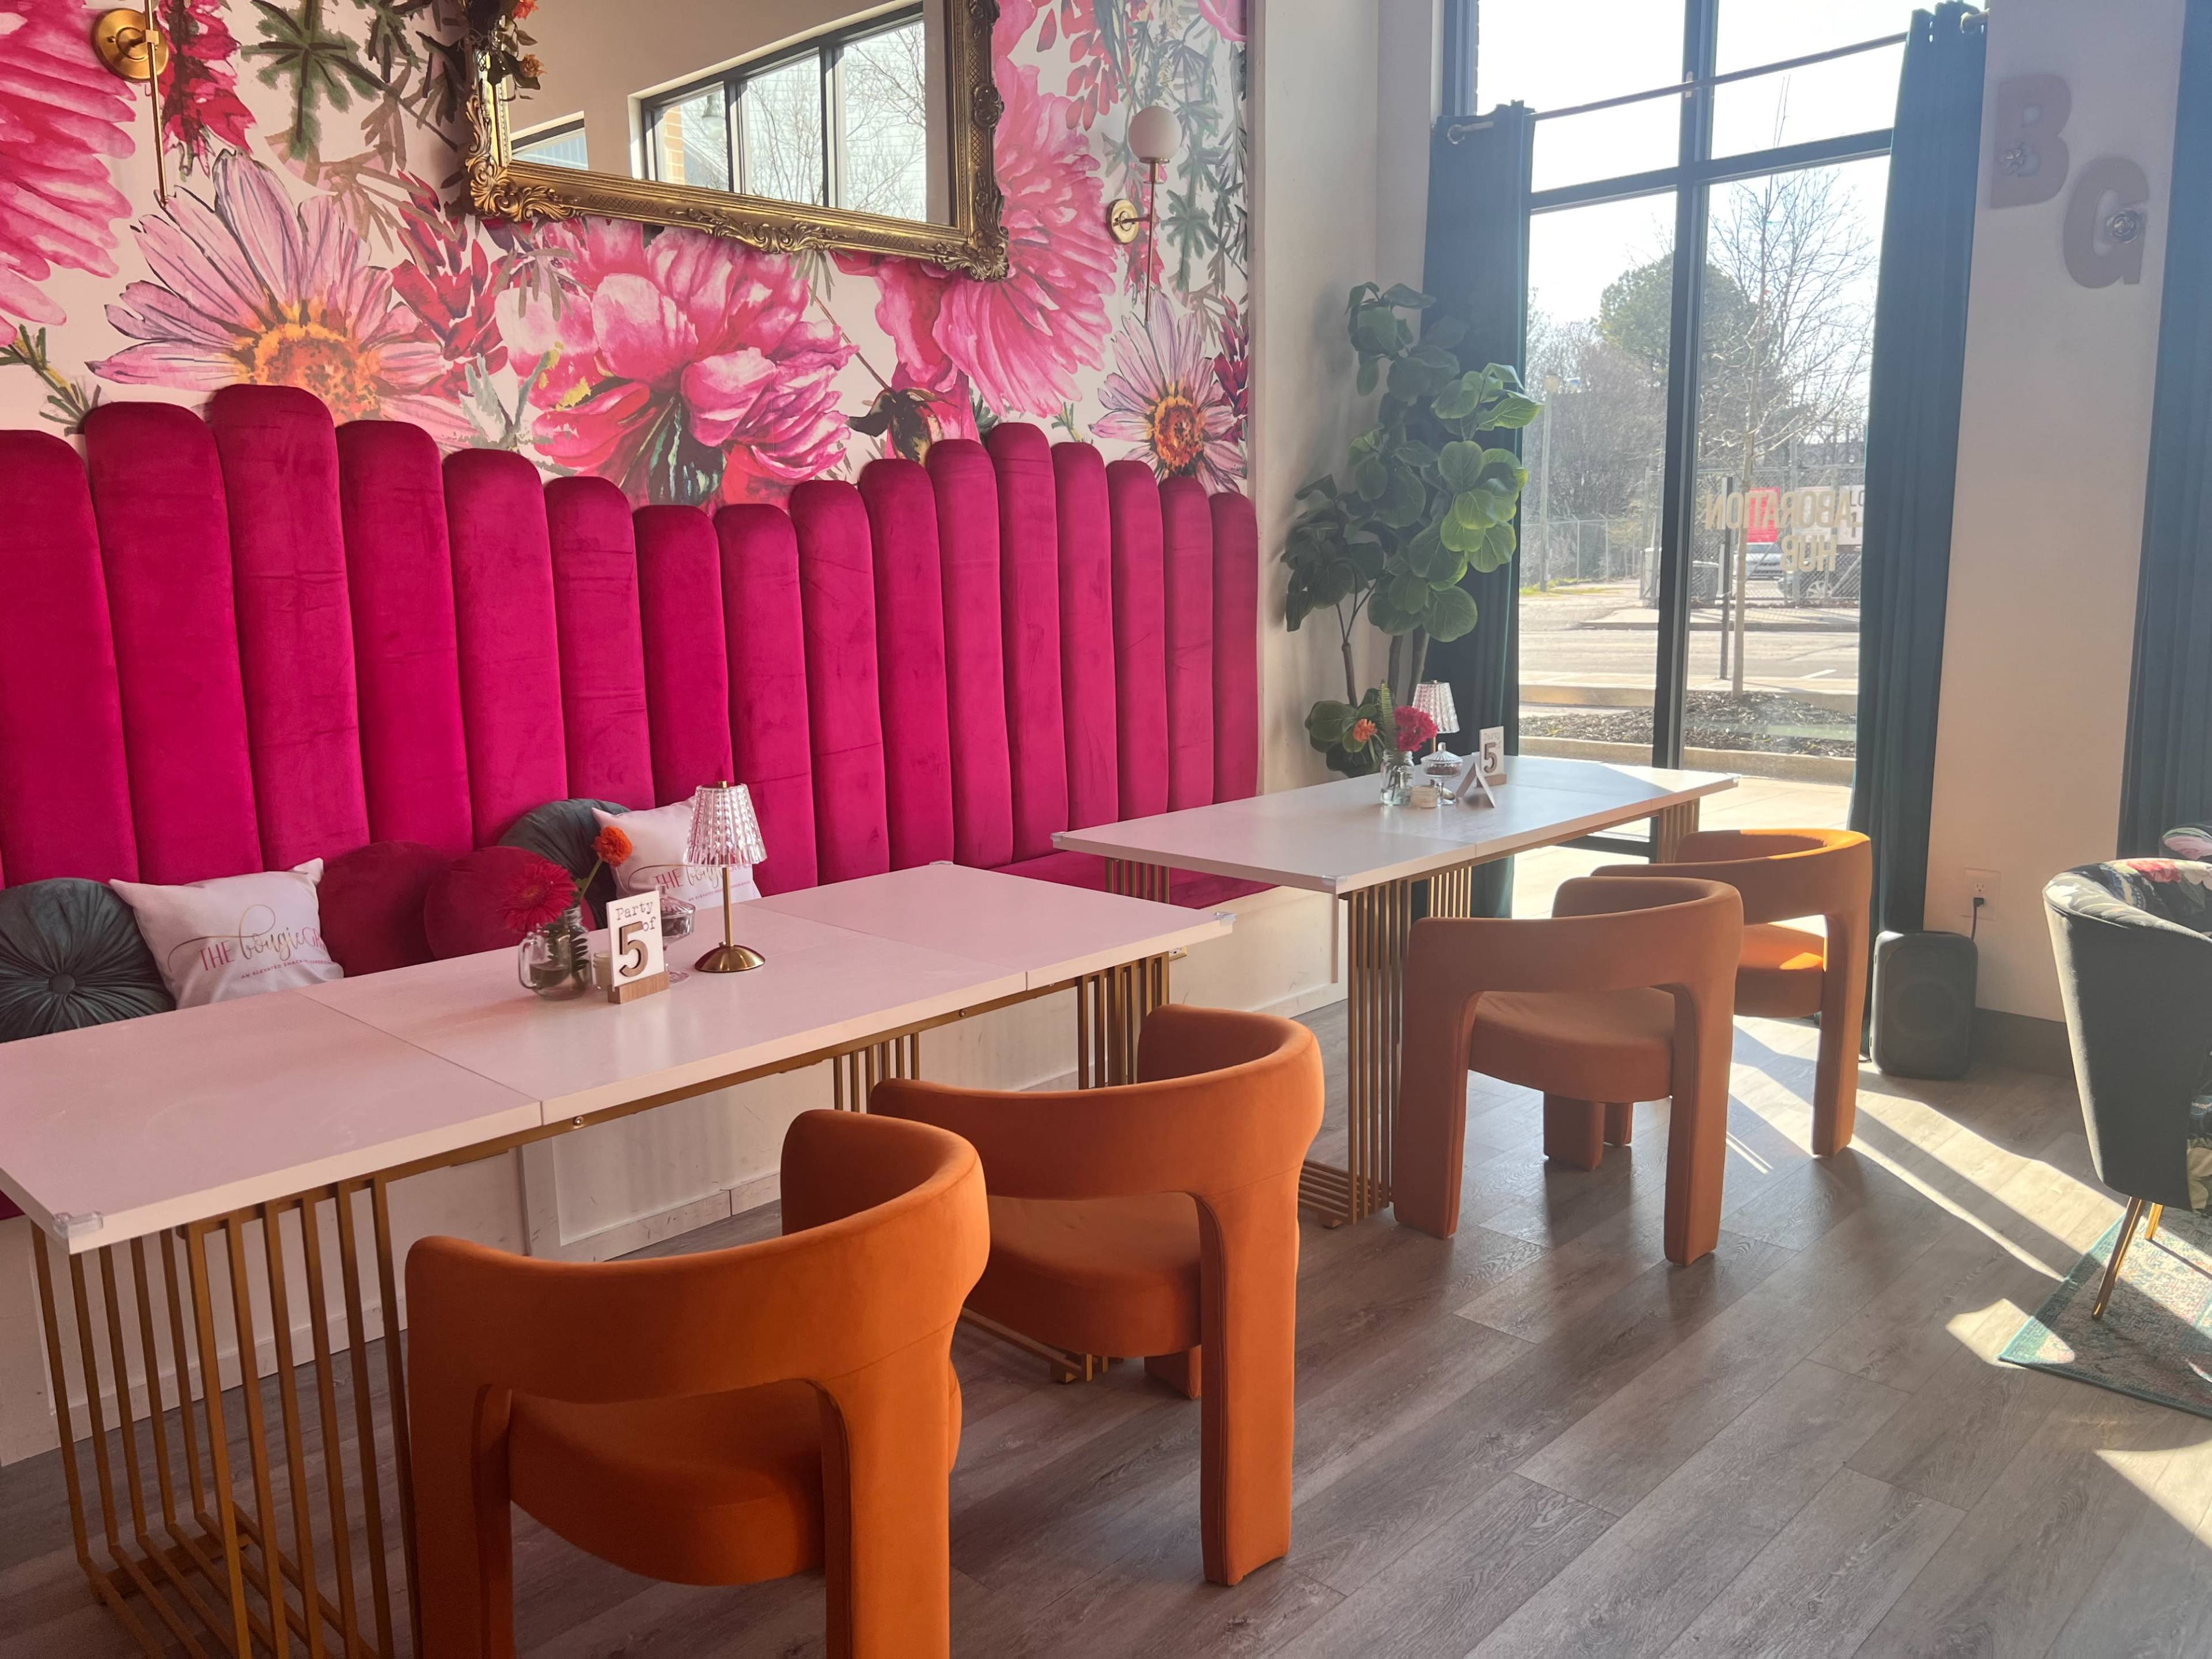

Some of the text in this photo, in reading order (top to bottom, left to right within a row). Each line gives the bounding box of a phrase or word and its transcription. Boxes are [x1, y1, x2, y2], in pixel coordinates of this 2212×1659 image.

[1484, 742, 1498, 774] 5
[654, 868, 684, 889] THE
[615, 901, 653, 921] Party
[643, 916, 656, 931] of
[198, 939, 236, 972] THE
[619, 921, 649, 978] 5
